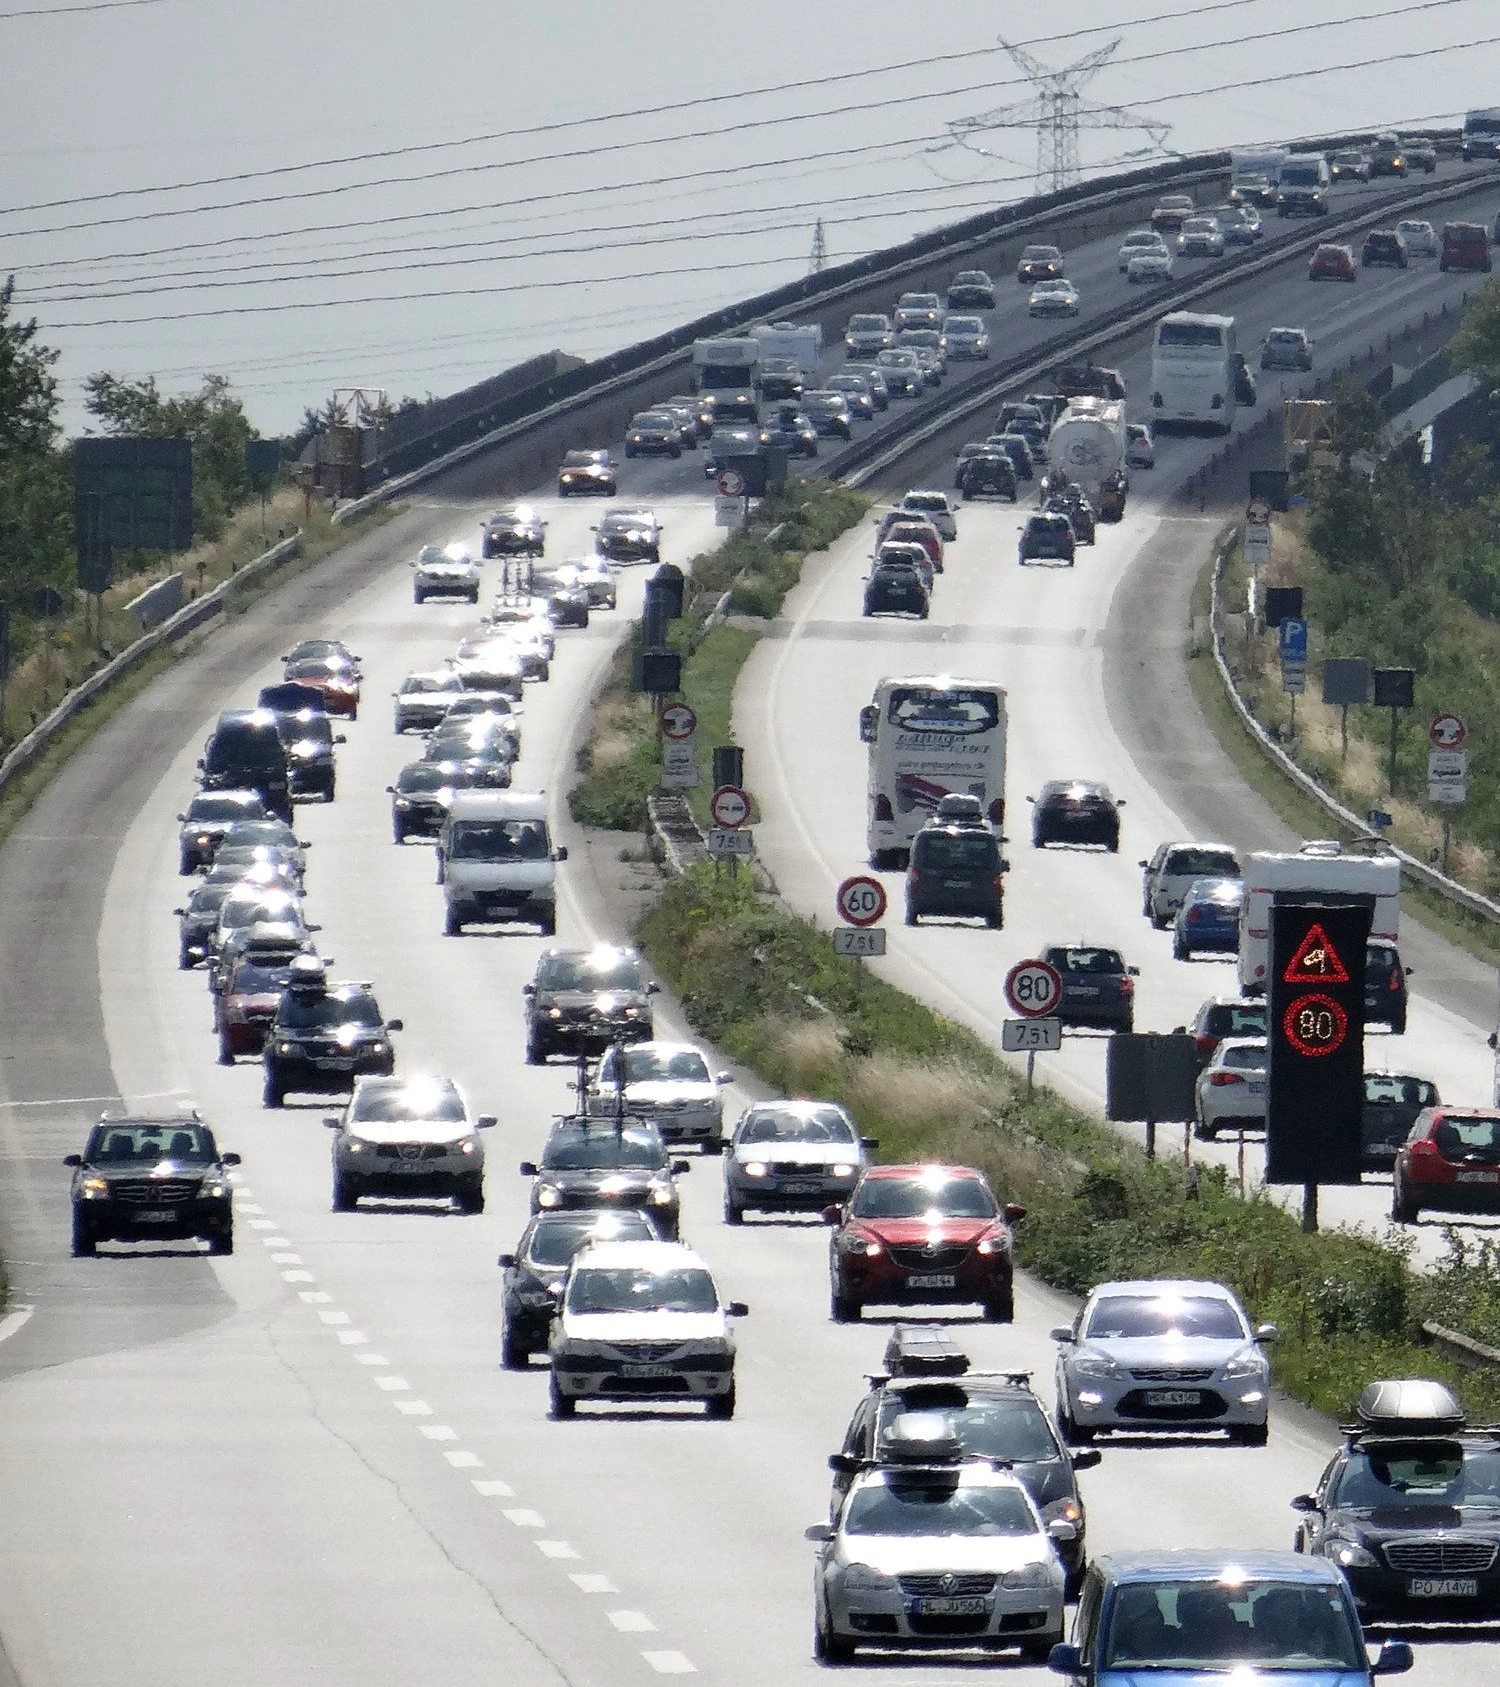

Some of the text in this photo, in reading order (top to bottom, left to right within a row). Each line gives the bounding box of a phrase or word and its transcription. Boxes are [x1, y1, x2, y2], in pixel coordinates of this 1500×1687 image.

[847, 890, 876, 912] 60
[1017, 974, 1050, 1002] 80
[1300, 1009, 1333, 1040] 80
